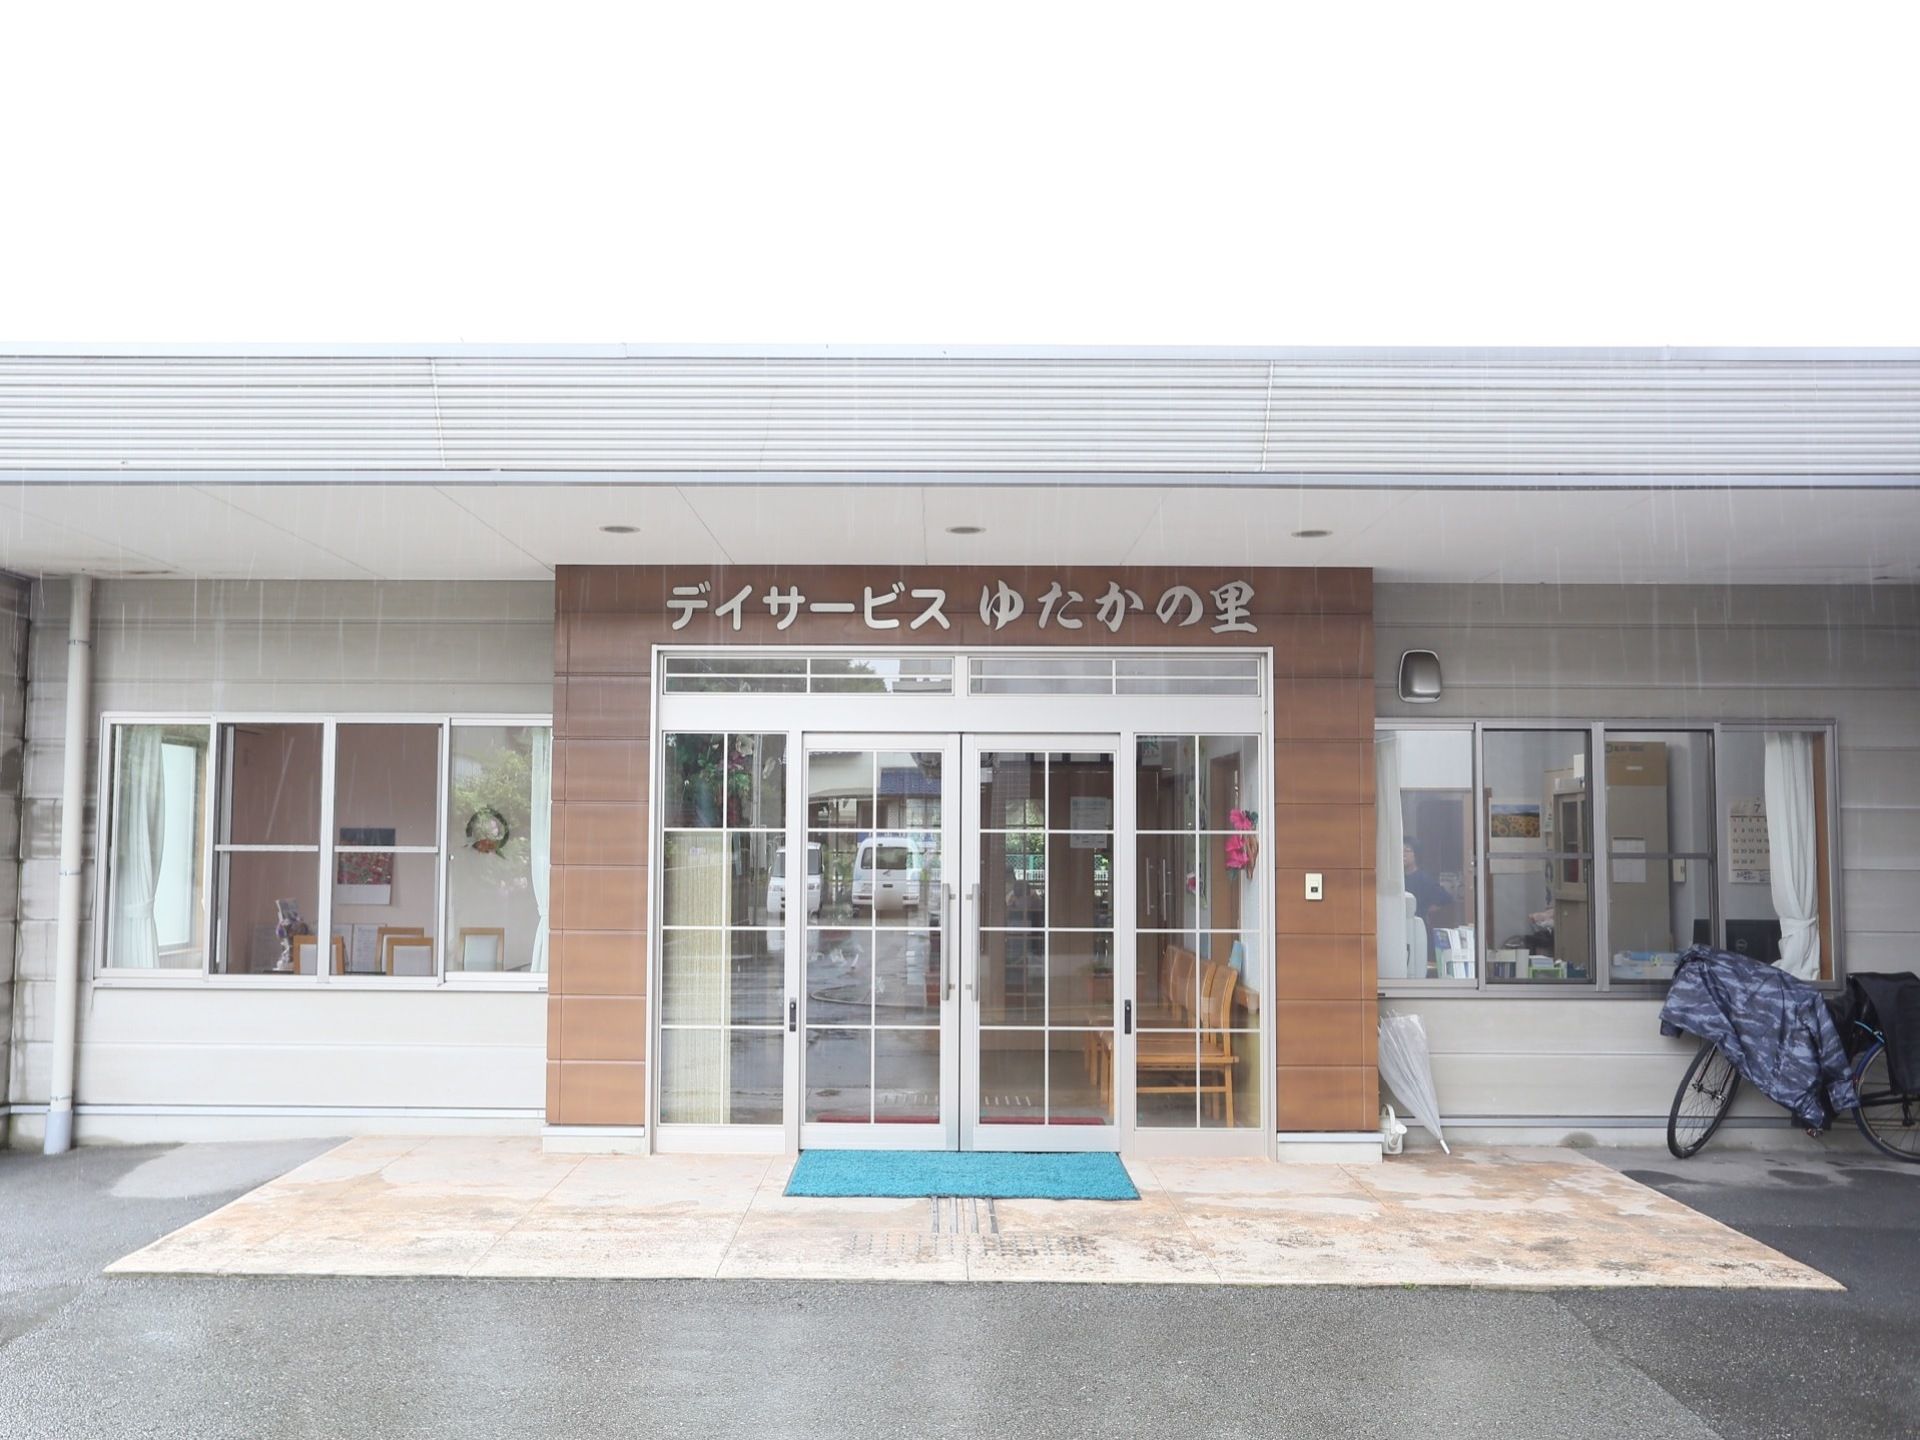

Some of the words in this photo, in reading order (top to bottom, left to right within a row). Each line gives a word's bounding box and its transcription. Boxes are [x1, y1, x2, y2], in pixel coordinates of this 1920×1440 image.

[666, 580, 950, 631] デイサービス
[979, 580, 1257, 634] ゆたかの里
